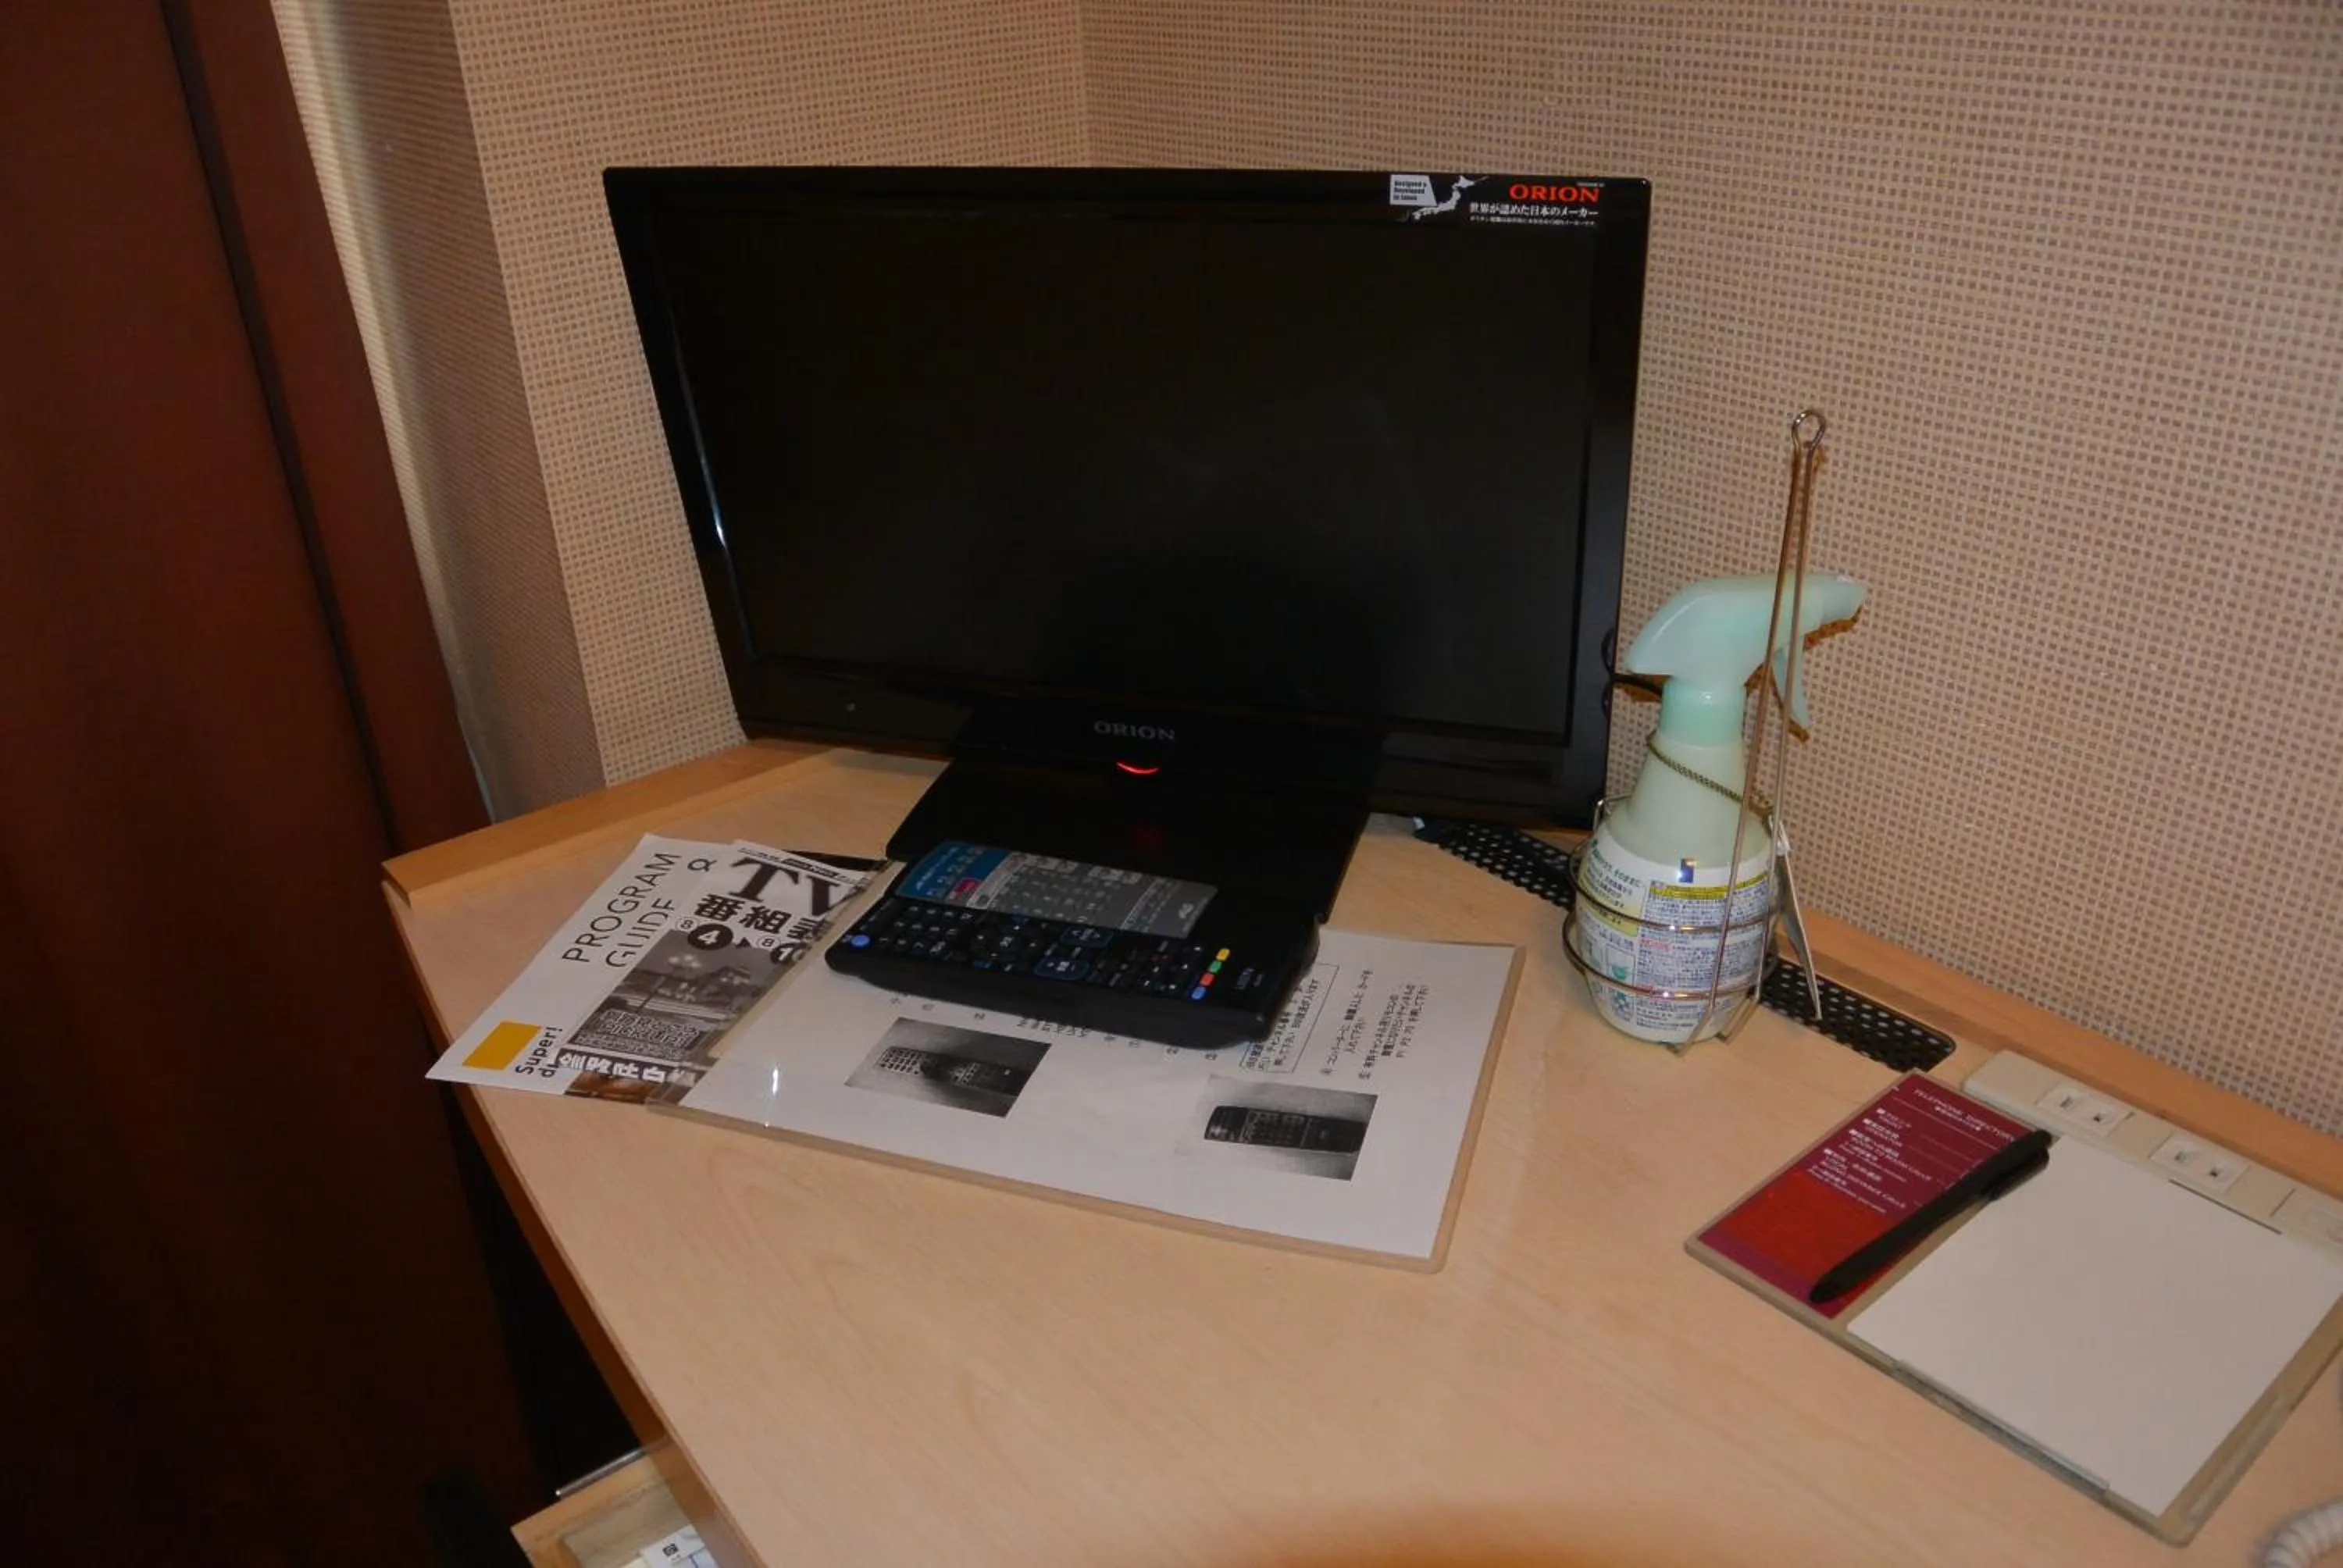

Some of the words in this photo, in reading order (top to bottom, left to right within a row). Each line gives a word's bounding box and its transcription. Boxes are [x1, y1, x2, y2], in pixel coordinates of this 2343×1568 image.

[1509, 183, 1599, 202] ORION
[1093, 721, 1175, 740] ORION
[562, 853, 683, 963] PROGRAM
[729, 856, 868, 917] TV
[605, 898, 675, 968] GUIDE
[515, 1025, 563, 1075] Super!
